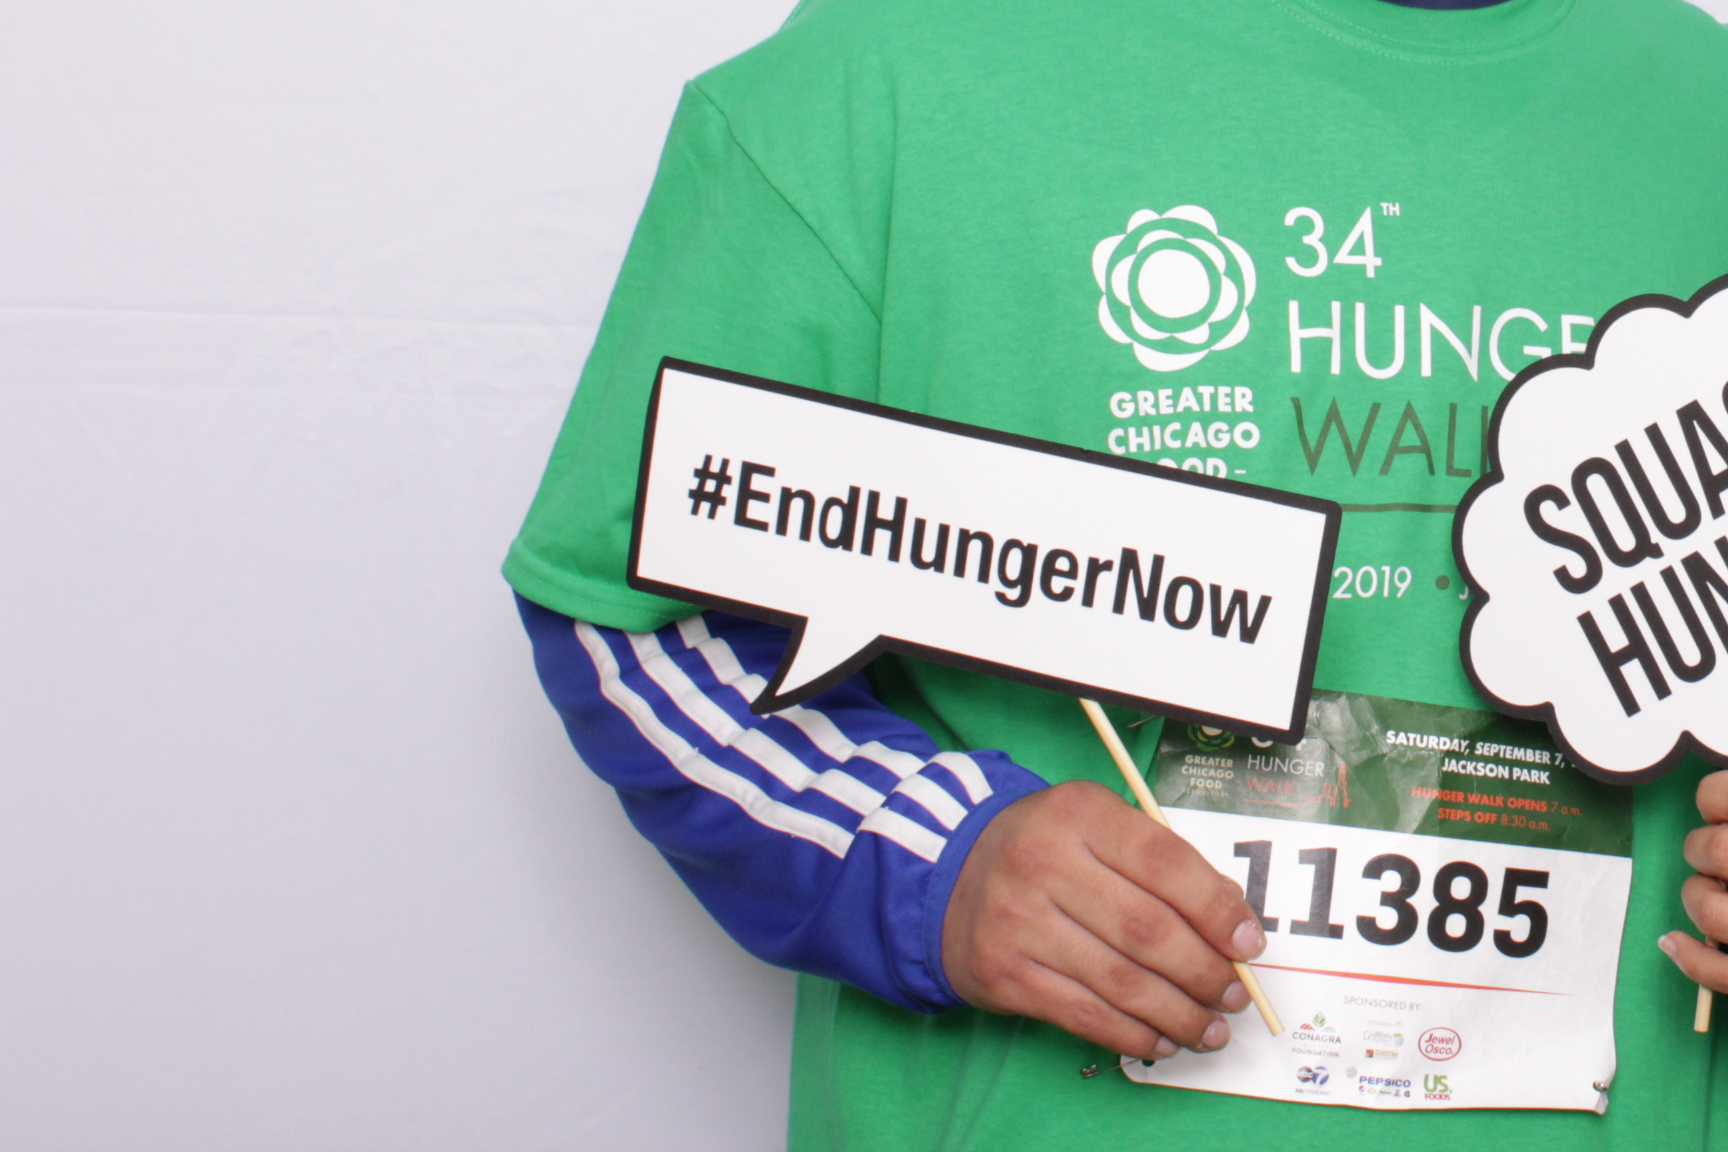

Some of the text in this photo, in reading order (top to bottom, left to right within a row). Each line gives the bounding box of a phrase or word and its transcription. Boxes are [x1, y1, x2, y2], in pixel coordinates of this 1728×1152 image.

[1288, 300, 1595, 382] HUNGE
[1109, 385, 1254, 419] GREATER
[1107, 421, 1261, 455] CHICAGO
[1290, 396, 1489, 478] WAL
[687, 452, 1273, 645] #EndHungerNow
[1332, 566, 1412, 599] 2019
[1386, 730, 1470, 756] SATURDAY,
[1474, 741, 1551, 765] SEPTEMBER
[1181, 765, 1235, 780] CHICAGO
[1184, 754, 1234, 768] GREATER
[1246, 754, 1326, 778] HUNGER
[1441, 757, 1551, 785] JACKSON PARK
[1189, 778, 1223, 789] FOOD
[1245, 776, 1297, 795] WALK
[1410, 786, 1583, 817] HUNGER WALK OPENS 7 a.m.
[1437, 807, 1551, 832] STEPS OFF 8:30 a.m.
[1233, 839, 1550, 958] 11385
[1343, 995, 1407, 1011] SPONSORED
[1291, 1031, 1342, 1044] CONAGRA
[1424, 1032, 1455, 1045] Jewel
[1291, 1047, 1340, 1058] FOUNDATION
[1359, 1075, 1411, 1088] PEPSICO
